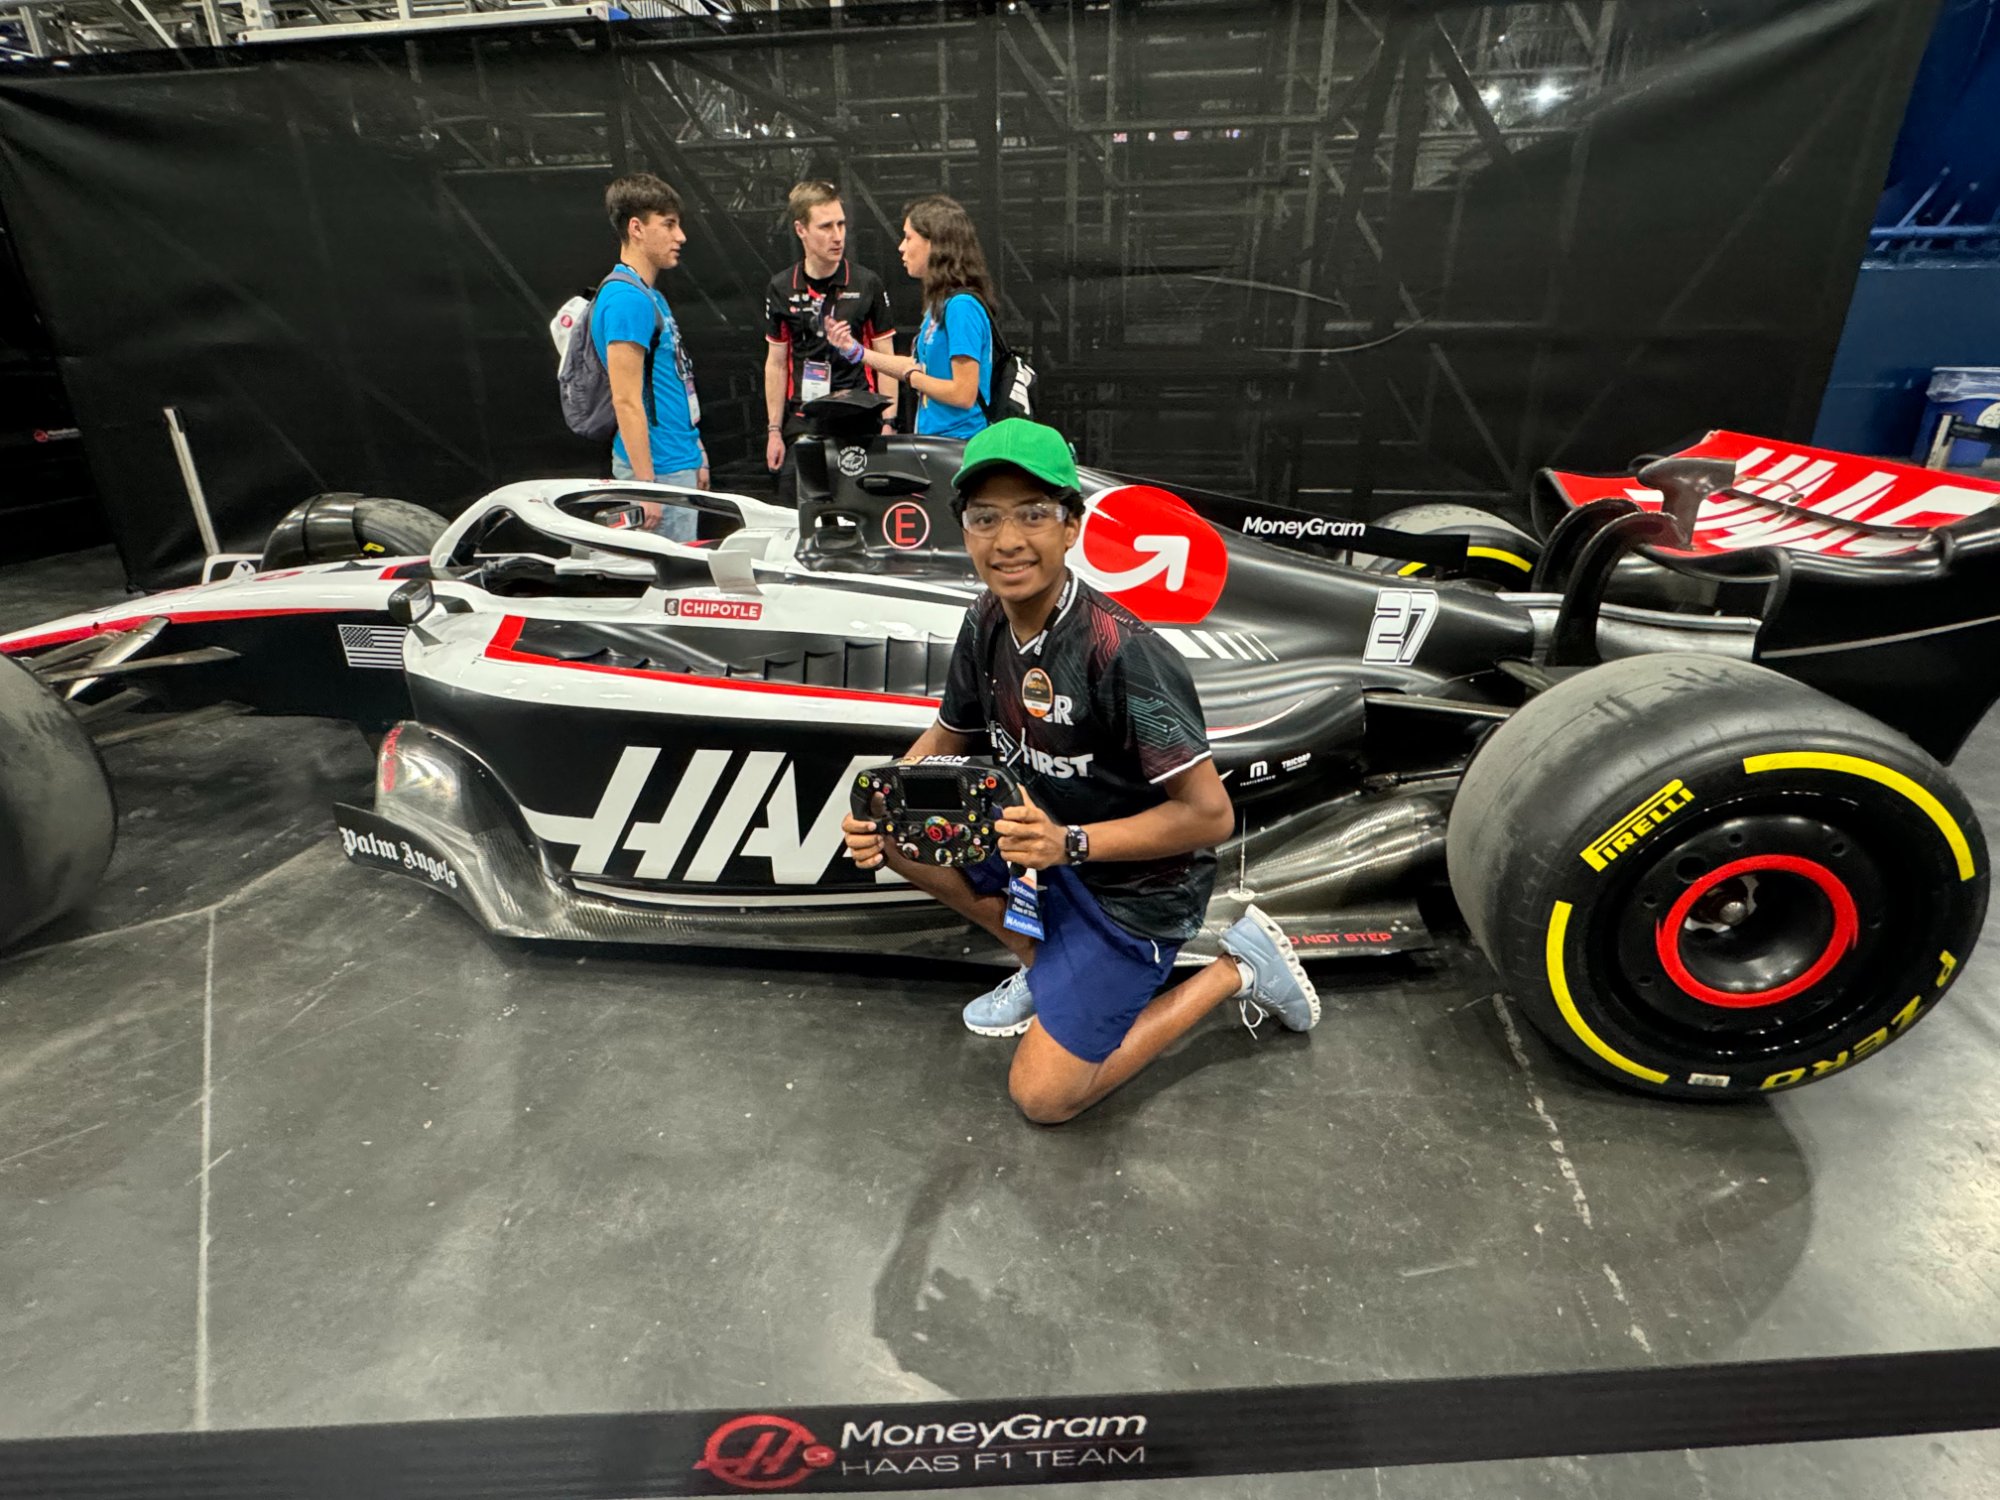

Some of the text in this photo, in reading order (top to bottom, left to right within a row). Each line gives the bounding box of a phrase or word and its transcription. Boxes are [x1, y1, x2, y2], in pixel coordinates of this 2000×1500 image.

[895, 508, 917, 543] E
[1242, 516, 1366, 539] MoneyGram
[683, 601, 760, 618] CHIPOTLE
[1362, 587, 1439, 666] 27
[1579, 779, 1695, 872] PIRELLI
[338, 826, 458, 889] Palm Angels
[1302, 933, 1339, 944] NOT
[1343, 932, 1392, 942] STEP
[1759, 995, 1922, 1090] ZERO
[841, 1413, 1148, 1449] MoneyGram
[842, 1446, 1145, 1476] HAAS F1 TEAM
